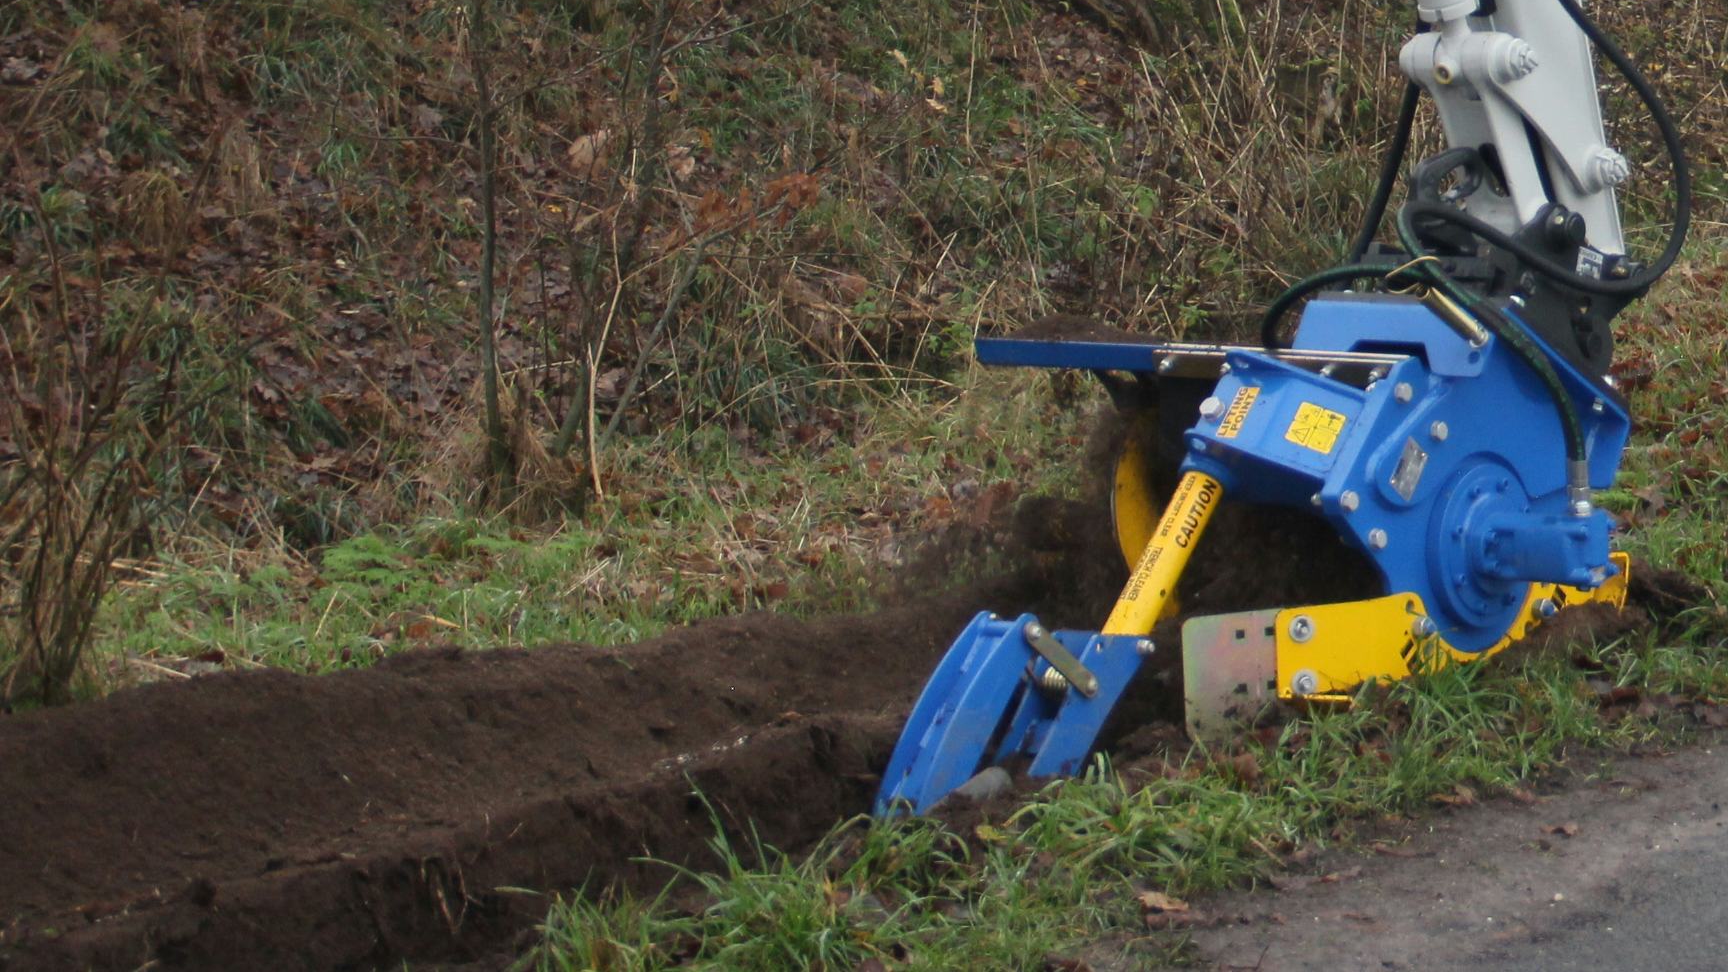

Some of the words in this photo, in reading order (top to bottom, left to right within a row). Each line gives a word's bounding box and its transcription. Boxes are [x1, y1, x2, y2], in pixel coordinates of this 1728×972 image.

[1217, 388, 1249, 436] LIFTING
[1230, 394, 1255, 431] POINT
[1175, 478, 1218, 549] CAUTION
